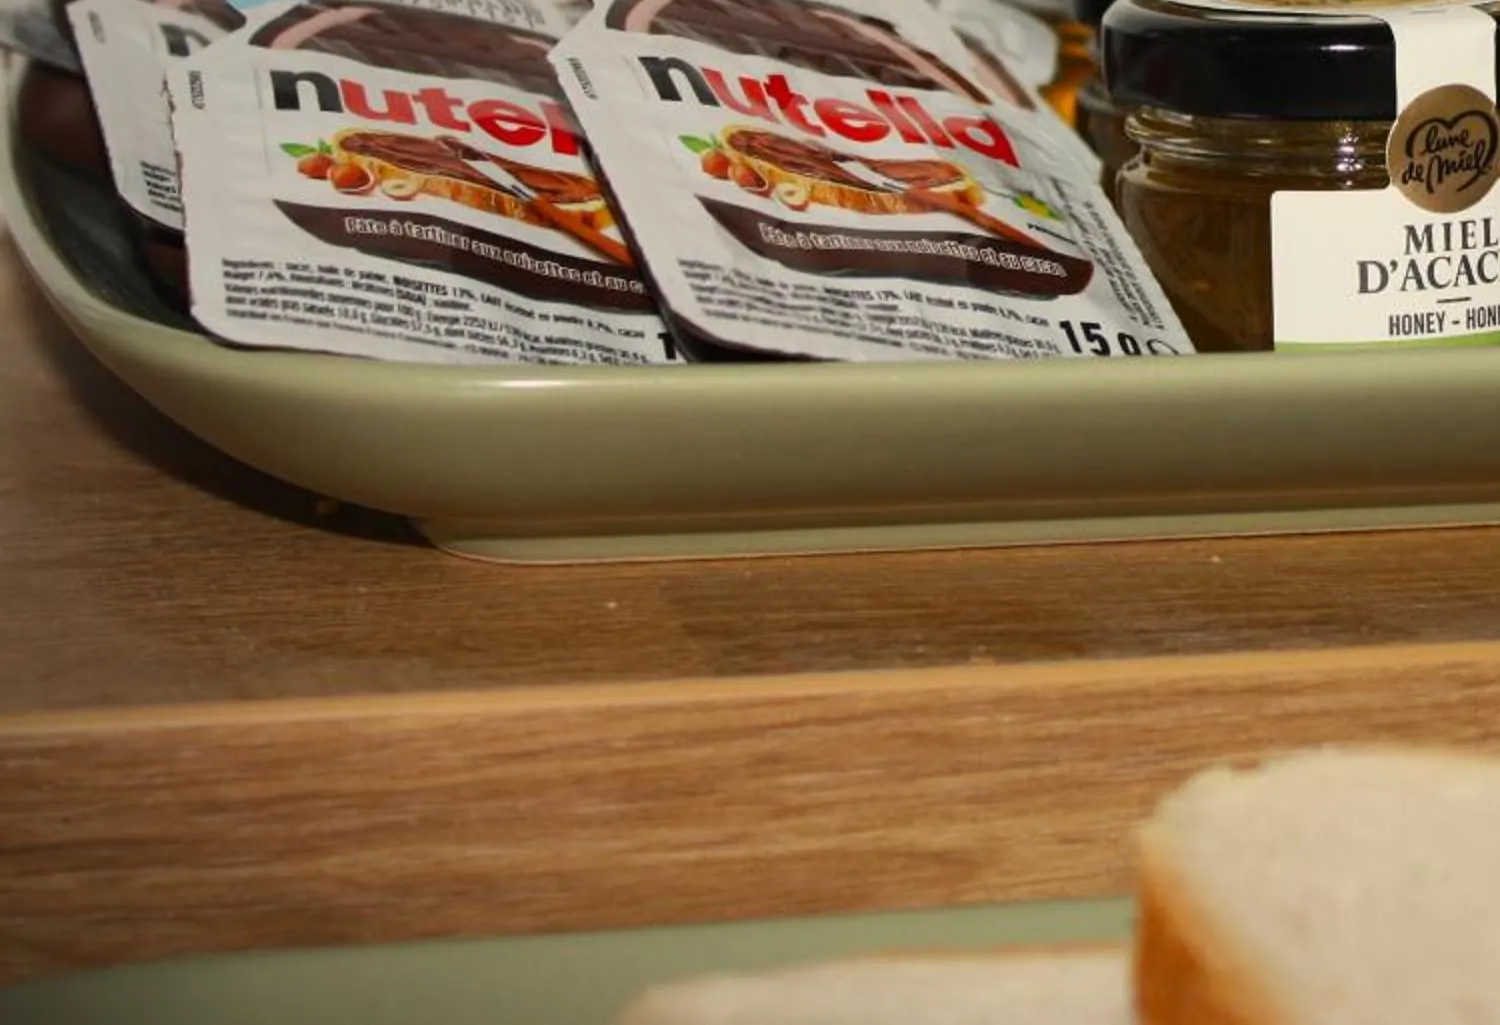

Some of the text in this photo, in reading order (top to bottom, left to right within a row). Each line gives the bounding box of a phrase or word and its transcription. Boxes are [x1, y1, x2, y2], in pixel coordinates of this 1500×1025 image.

[269, 69, 581, 157] nutel
[637, 55, 1021, 170] nutella
[1404, 217, 1499, 256] MIEL
[1058, 320, 1112, 358] 15
[1388, 310, 1446, 336] HONEY
[657, 331, 680, 361] 1
